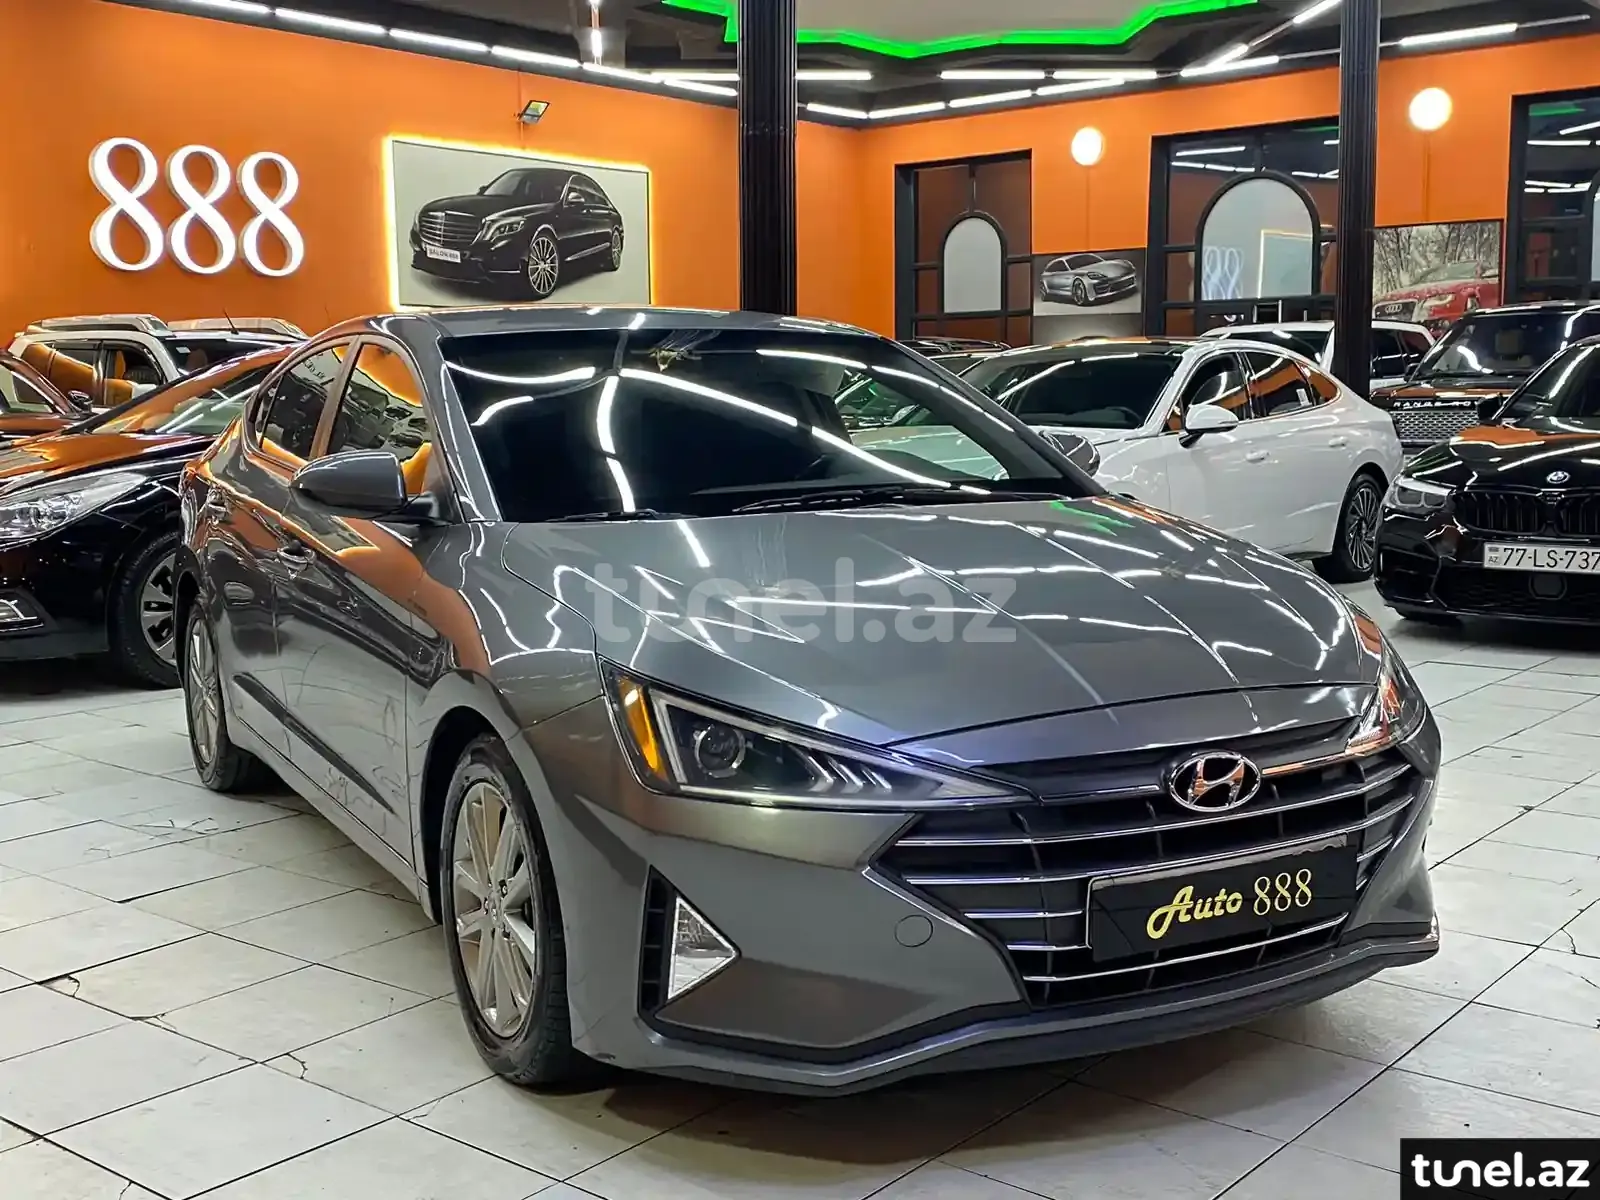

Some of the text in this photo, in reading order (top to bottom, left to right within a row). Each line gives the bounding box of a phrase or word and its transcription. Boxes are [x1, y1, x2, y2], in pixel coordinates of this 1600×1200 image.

[88, 137, 305, 277] 888
[1488, 555, 1499, 564] AZ
[1503, 547, 1600, 571] 77-LS-737
[1146, 868, 1313, 940] Auto 888
